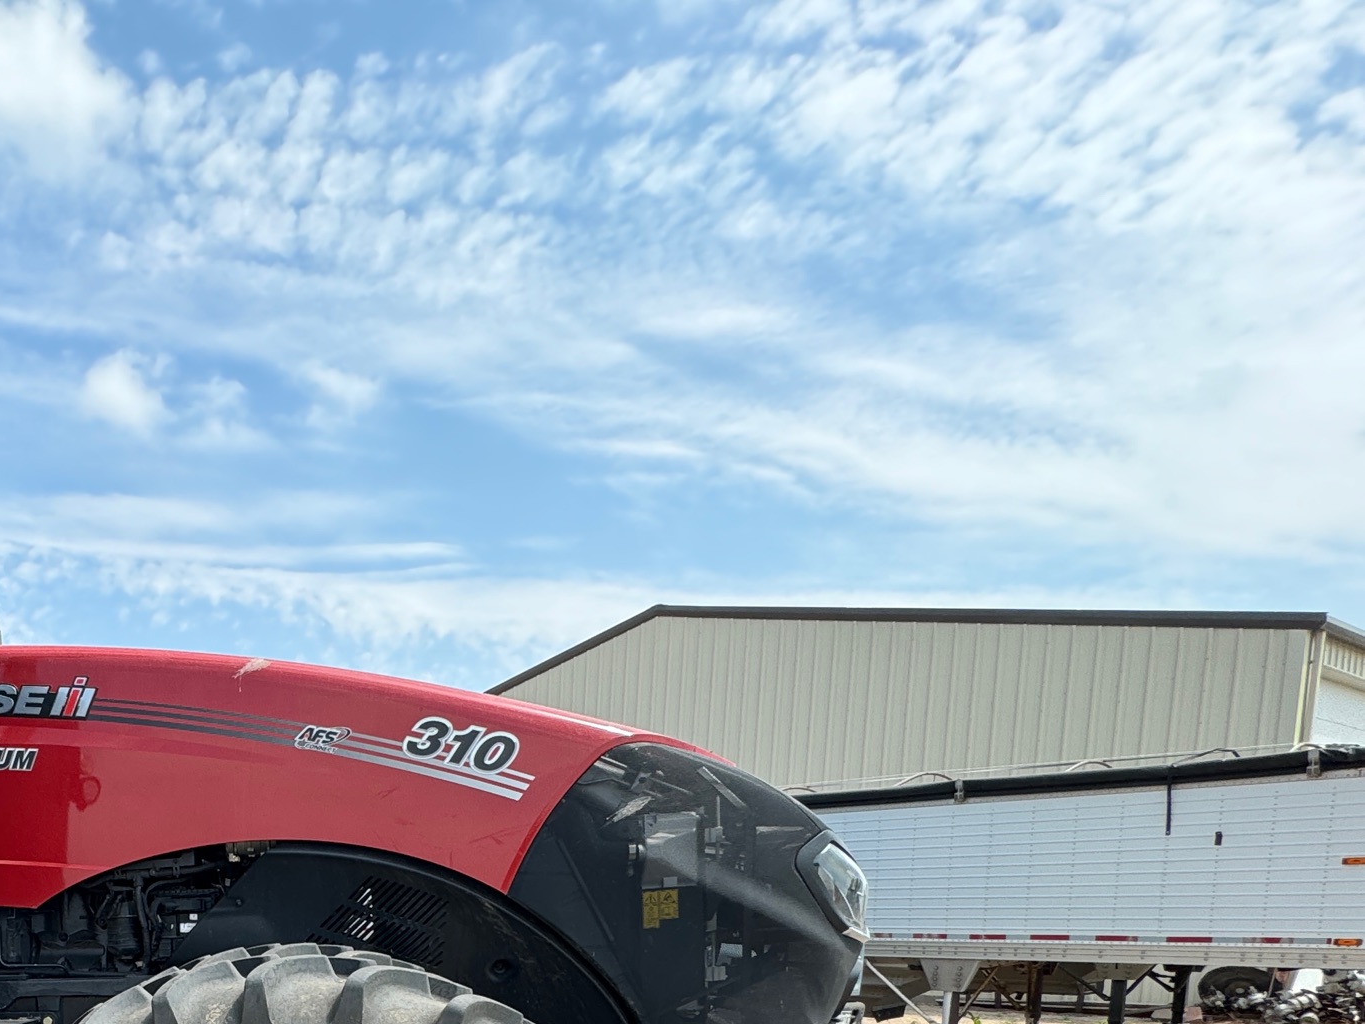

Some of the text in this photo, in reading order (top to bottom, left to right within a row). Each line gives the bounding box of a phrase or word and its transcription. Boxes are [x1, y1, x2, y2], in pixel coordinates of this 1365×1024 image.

[295, 725, 341, 745] AFS
[304, 743, 338, 753] CONNECT
[402, 716, 520, 775] 310
